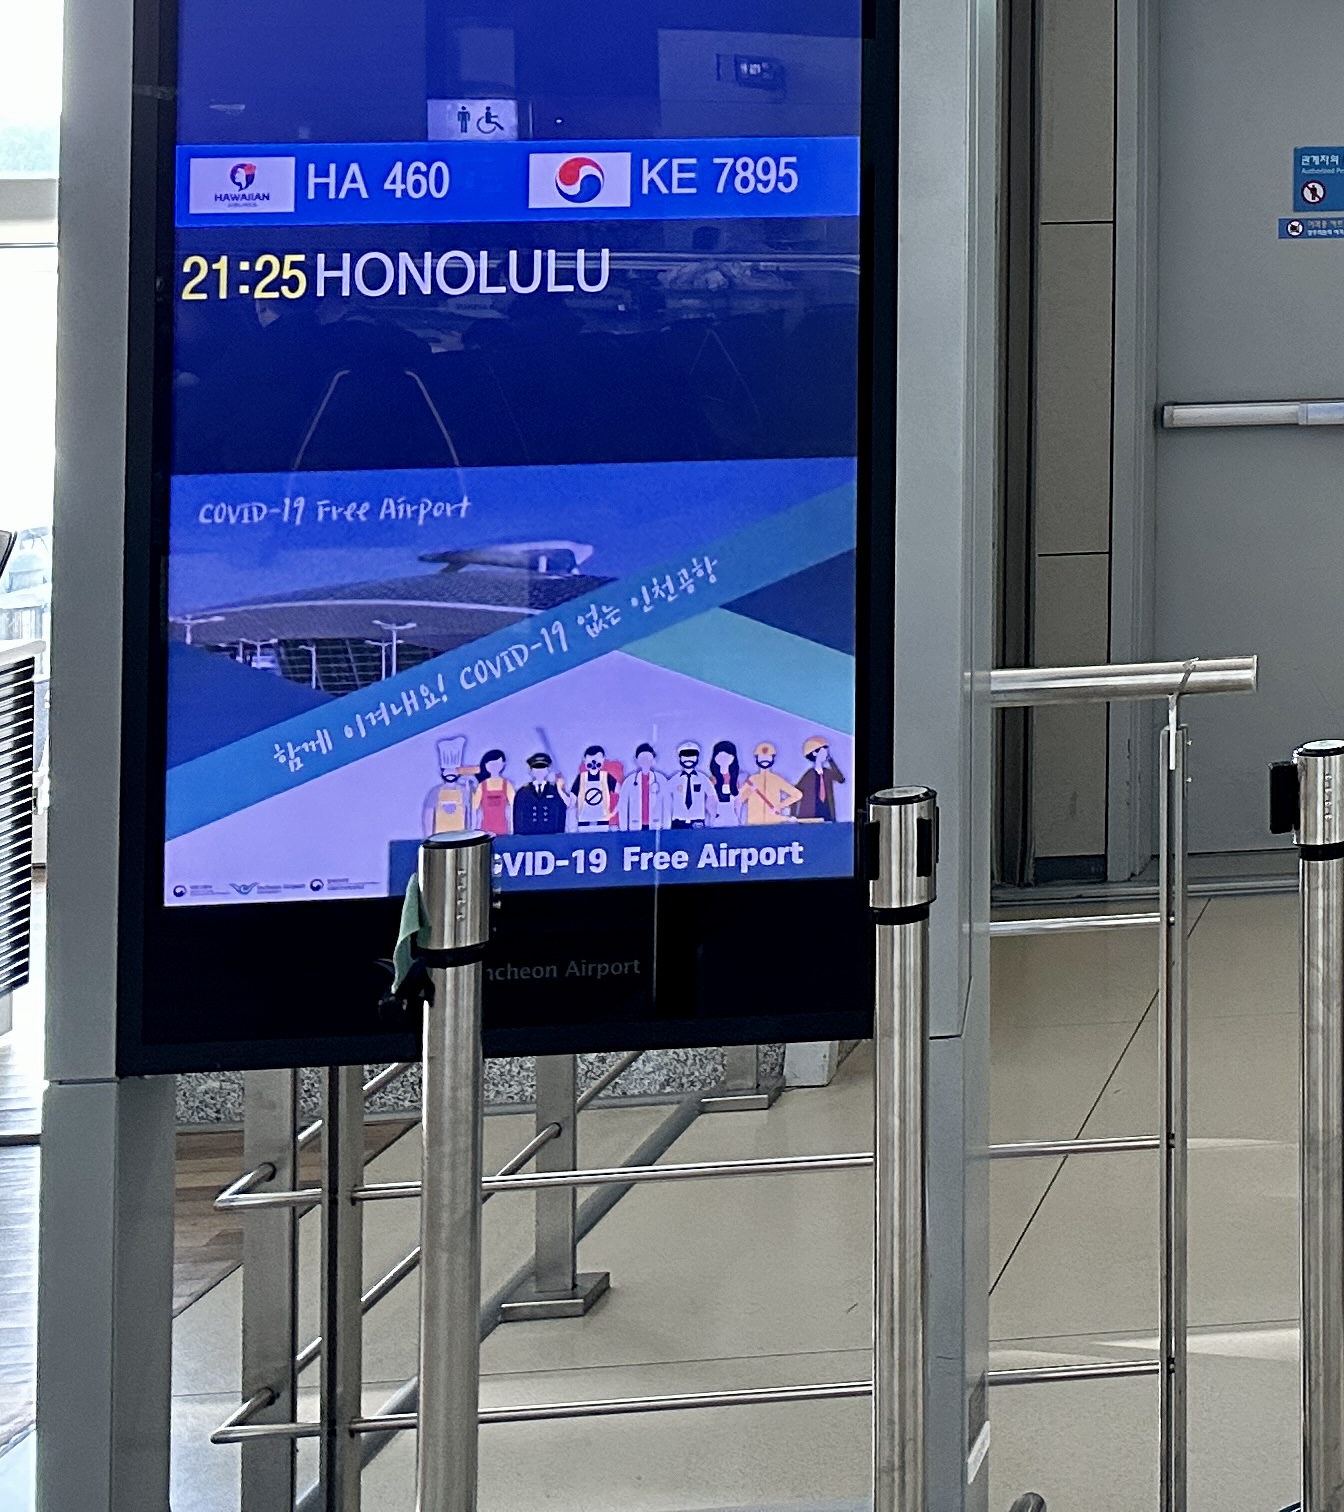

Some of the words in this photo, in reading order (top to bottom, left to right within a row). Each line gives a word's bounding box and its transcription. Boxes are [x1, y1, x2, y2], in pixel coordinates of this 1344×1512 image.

[307, 162, 369, 200] HA
[384, 161, 450, 199] 460
[641, 158, 698, 195] KE
[713, 156, 799, 194] 7895
[214, 192, 270, 202] HAWAIIAN
[181, 253, 308, 301] 21:25
[316, 248, 610, 297] HONOLULU
[198, 496, 305, 525] COVID-19
[317, 500, 367, 521] Free
[379, 495, 472, 525] Airport
[273, 728, 333, 773] 함께
[459, 619, 569, 690] COVID-19
[576, 602, 622, 638] 없는
[630, 554, 718, 613] 인천공항
[622, 845, 689, 871] Free
[697, 840, 804, 877] Airport
[565, 959, 641, 980] Airport
